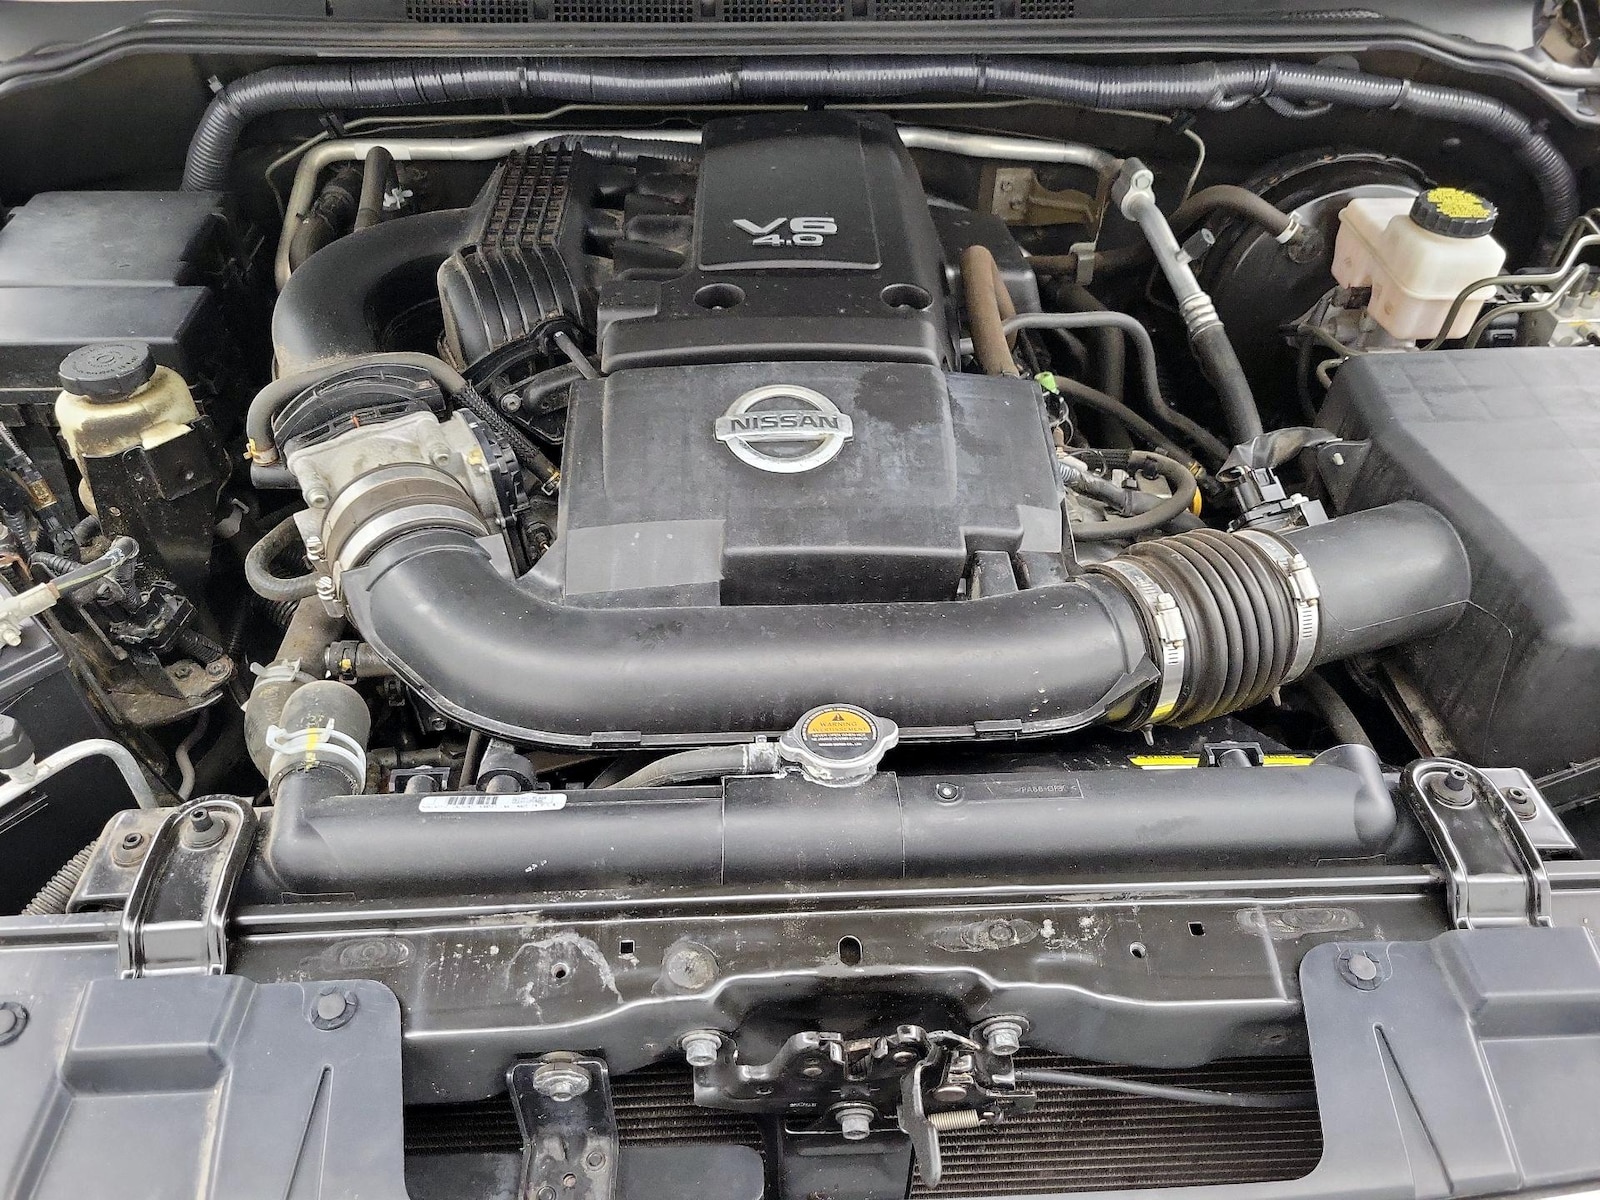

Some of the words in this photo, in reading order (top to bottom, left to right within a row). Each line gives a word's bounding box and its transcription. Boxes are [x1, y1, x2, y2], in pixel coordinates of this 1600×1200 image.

[732, 217, 838, 235] V6
[752, 233, 824, 247] 4.0
[730, 414, 839, 432] NISSAN
